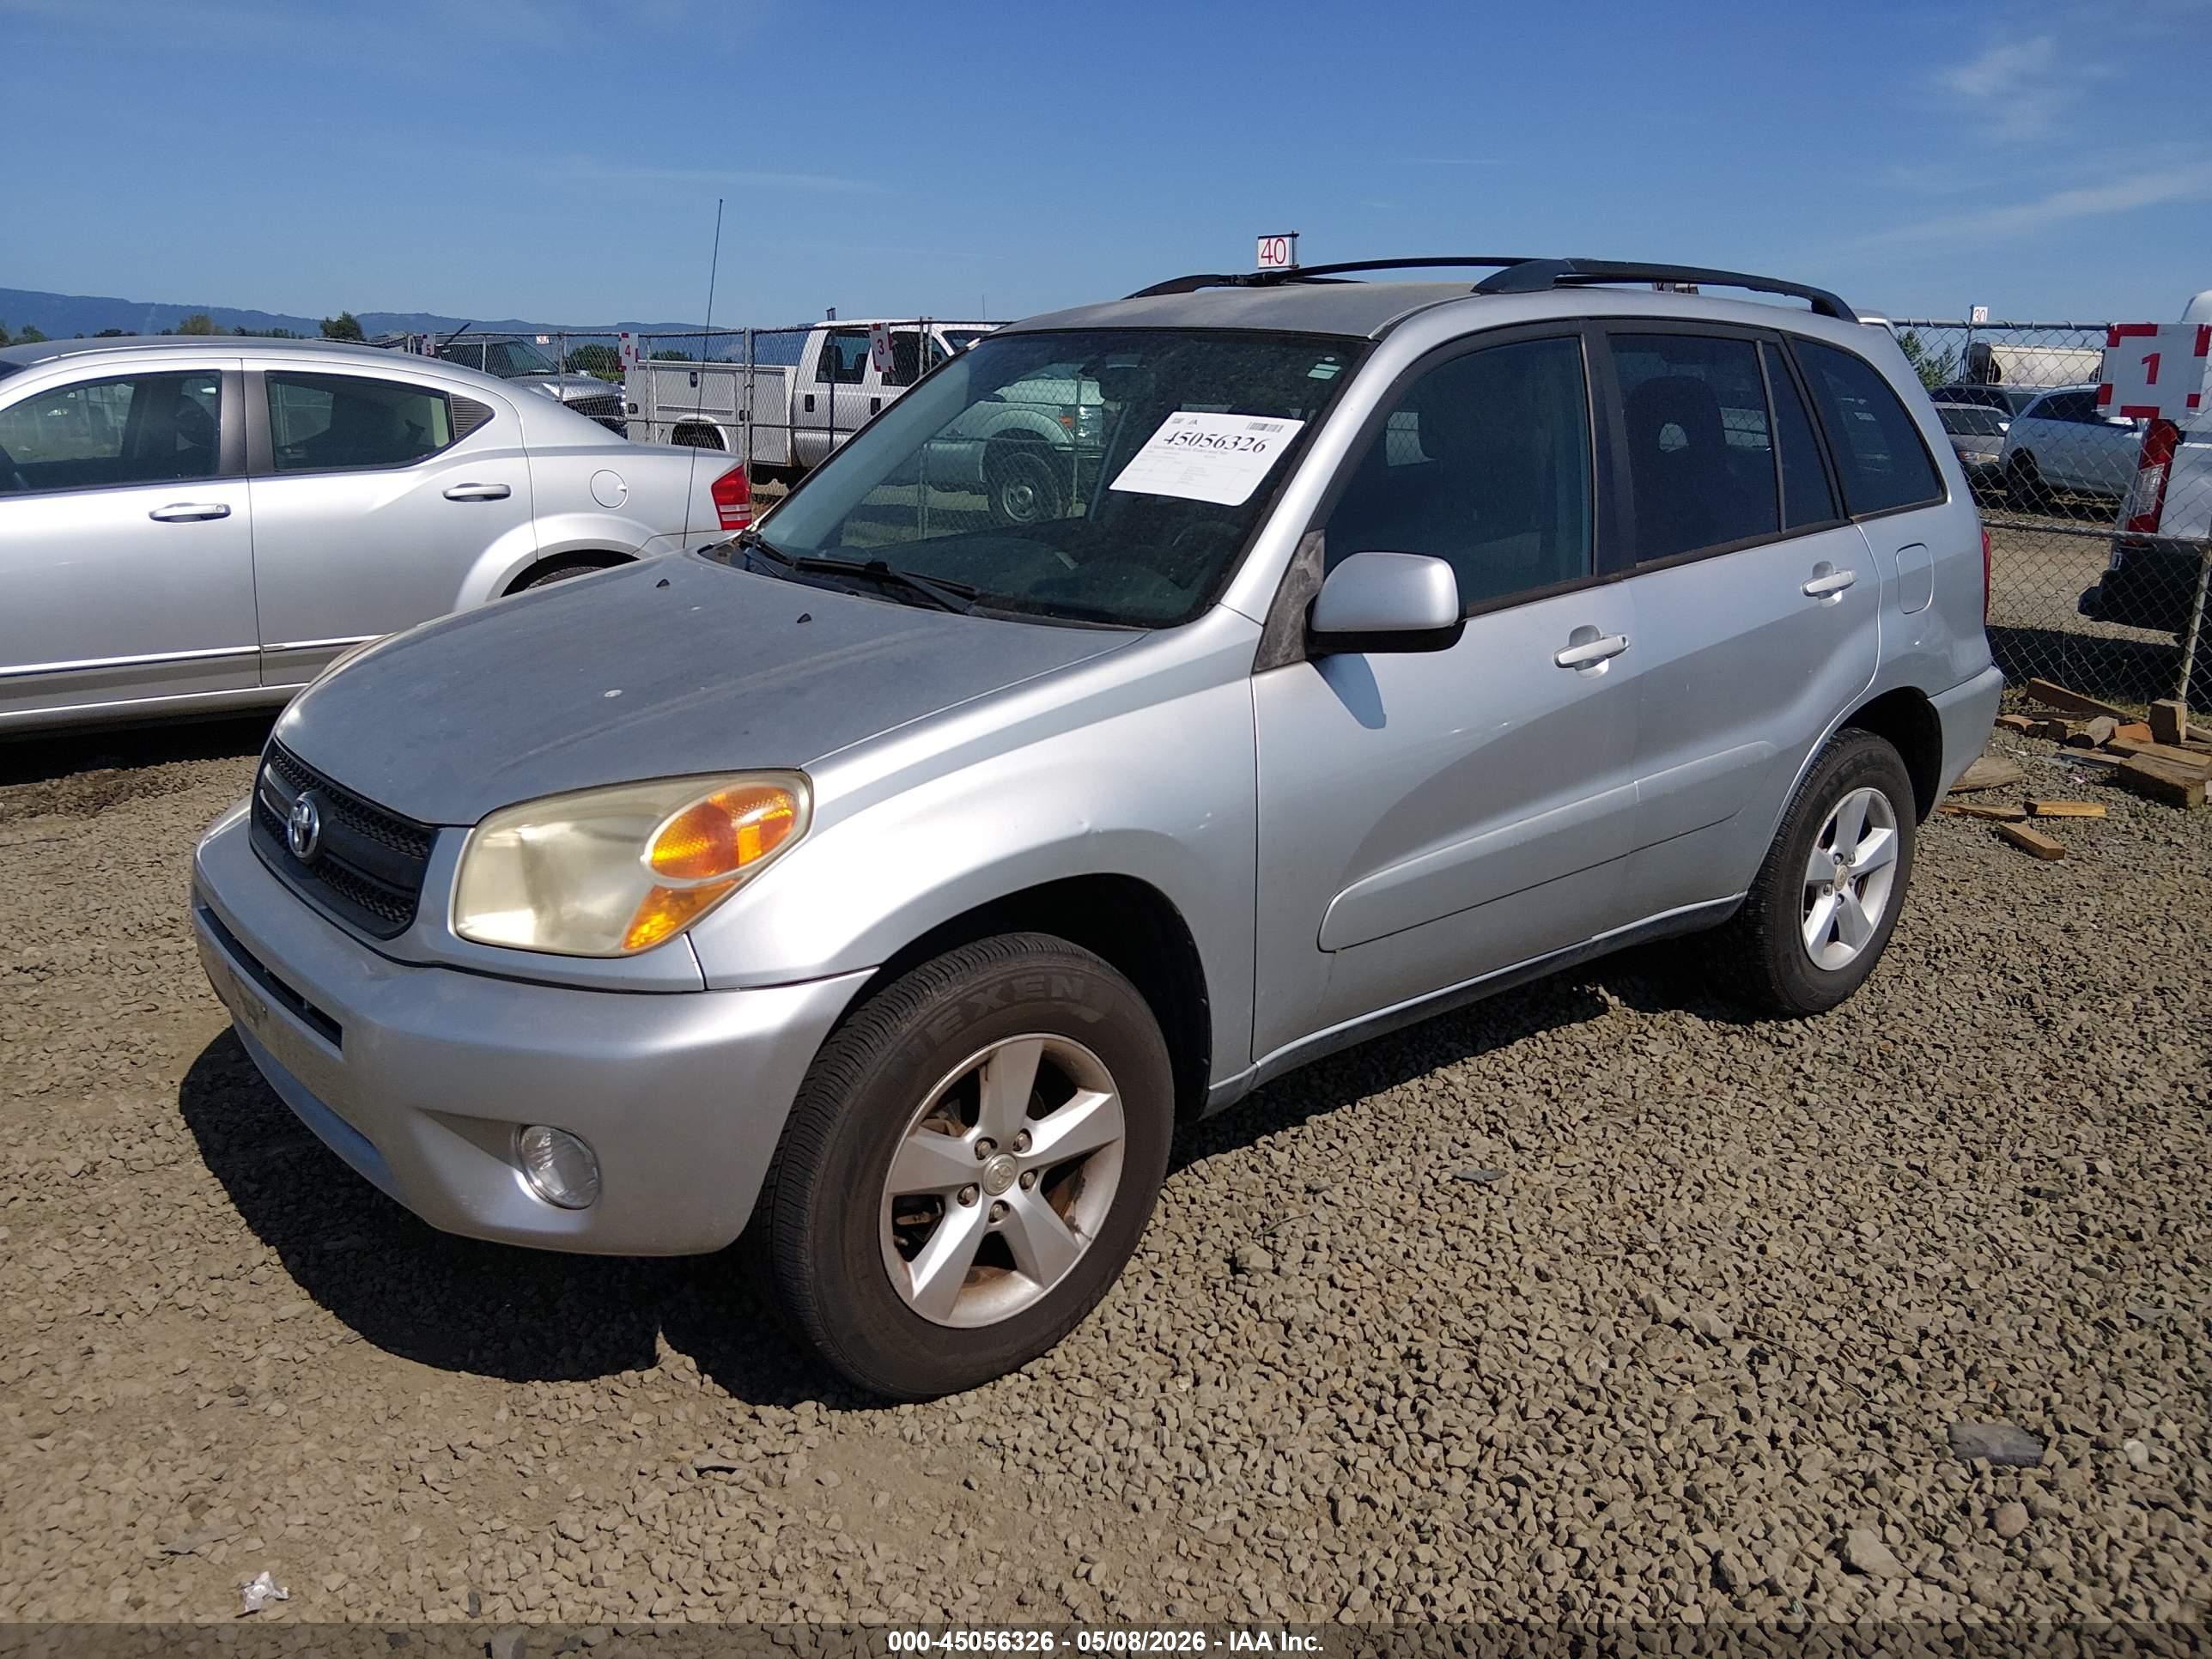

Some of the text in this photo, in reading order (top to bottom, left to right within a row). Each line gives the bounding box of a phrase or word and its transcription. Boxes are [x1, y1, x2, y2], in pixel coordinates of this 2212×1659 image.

[1261, 238, 1286, 264] 40
[1974, 308, 1986, 322] 30
[426, 344, 431, 356] 5
[624, 343, 631, 357] 4
[876, 338, 885, 356] 3
[2141, 352, 2161, 385] 1
[1164, 430, 1271, 453] 45056326
